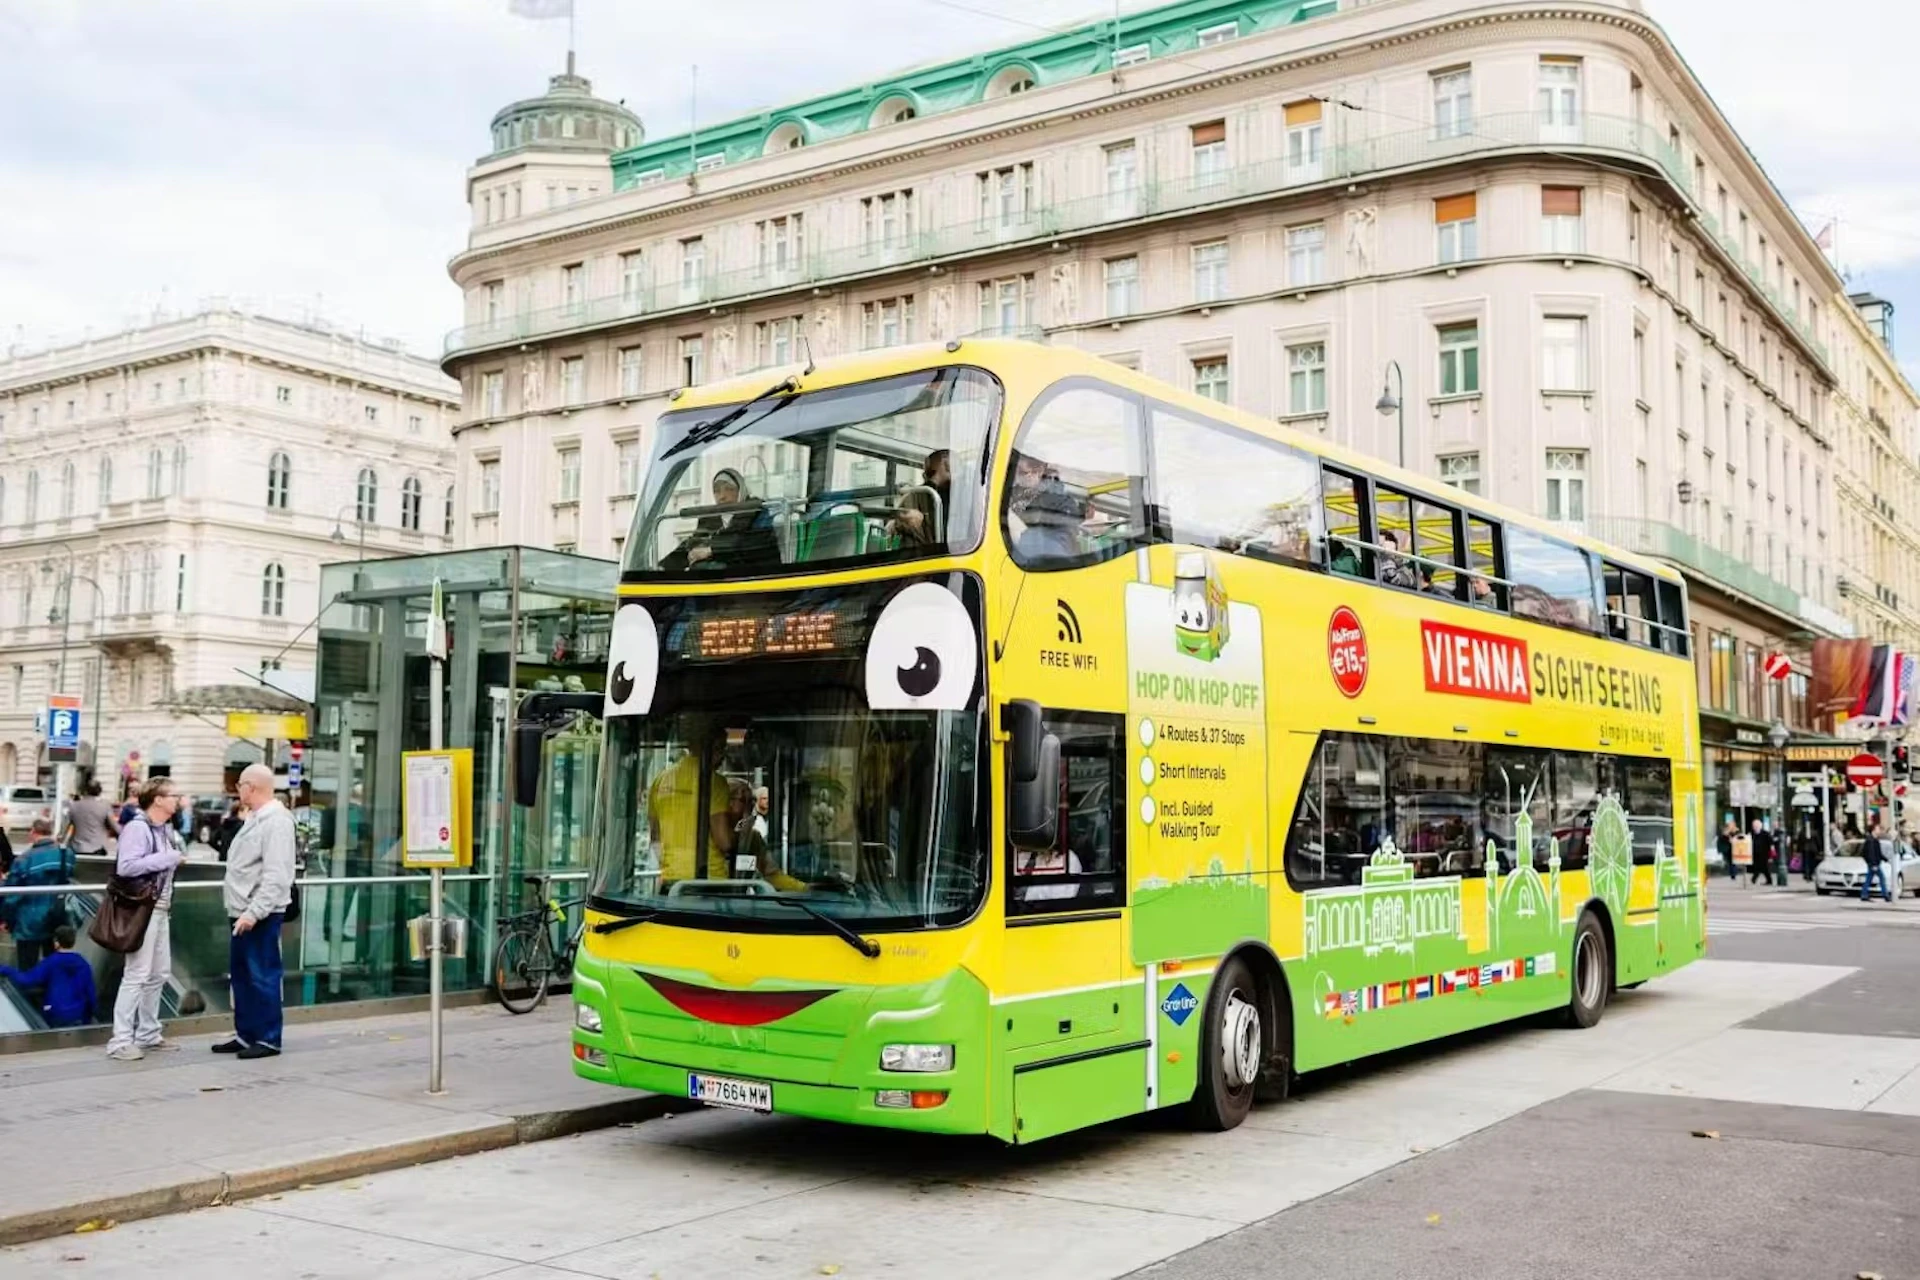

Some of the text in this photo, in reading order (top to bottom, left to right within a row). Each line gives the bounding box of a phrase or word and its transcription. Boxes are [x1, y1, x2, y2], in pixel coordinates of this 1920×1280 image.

[765, 613, 836, 652] LINE
[1040, 649, 1098, 671] FREE WIFI
[1424, 629, 1662, 715] VIENNA SIGHTSEEING
[1136, 671, 1258, 709] HOP ON HOP OFF
[1159, 723, 1246, 747] 4 Routes & 37 Stops
[1159, 762, 1226, 780] Short Intervals
[1160, 801, 1213, 817] Incl. Guided
[1160, 821, 1221, 841] Walking Tour
